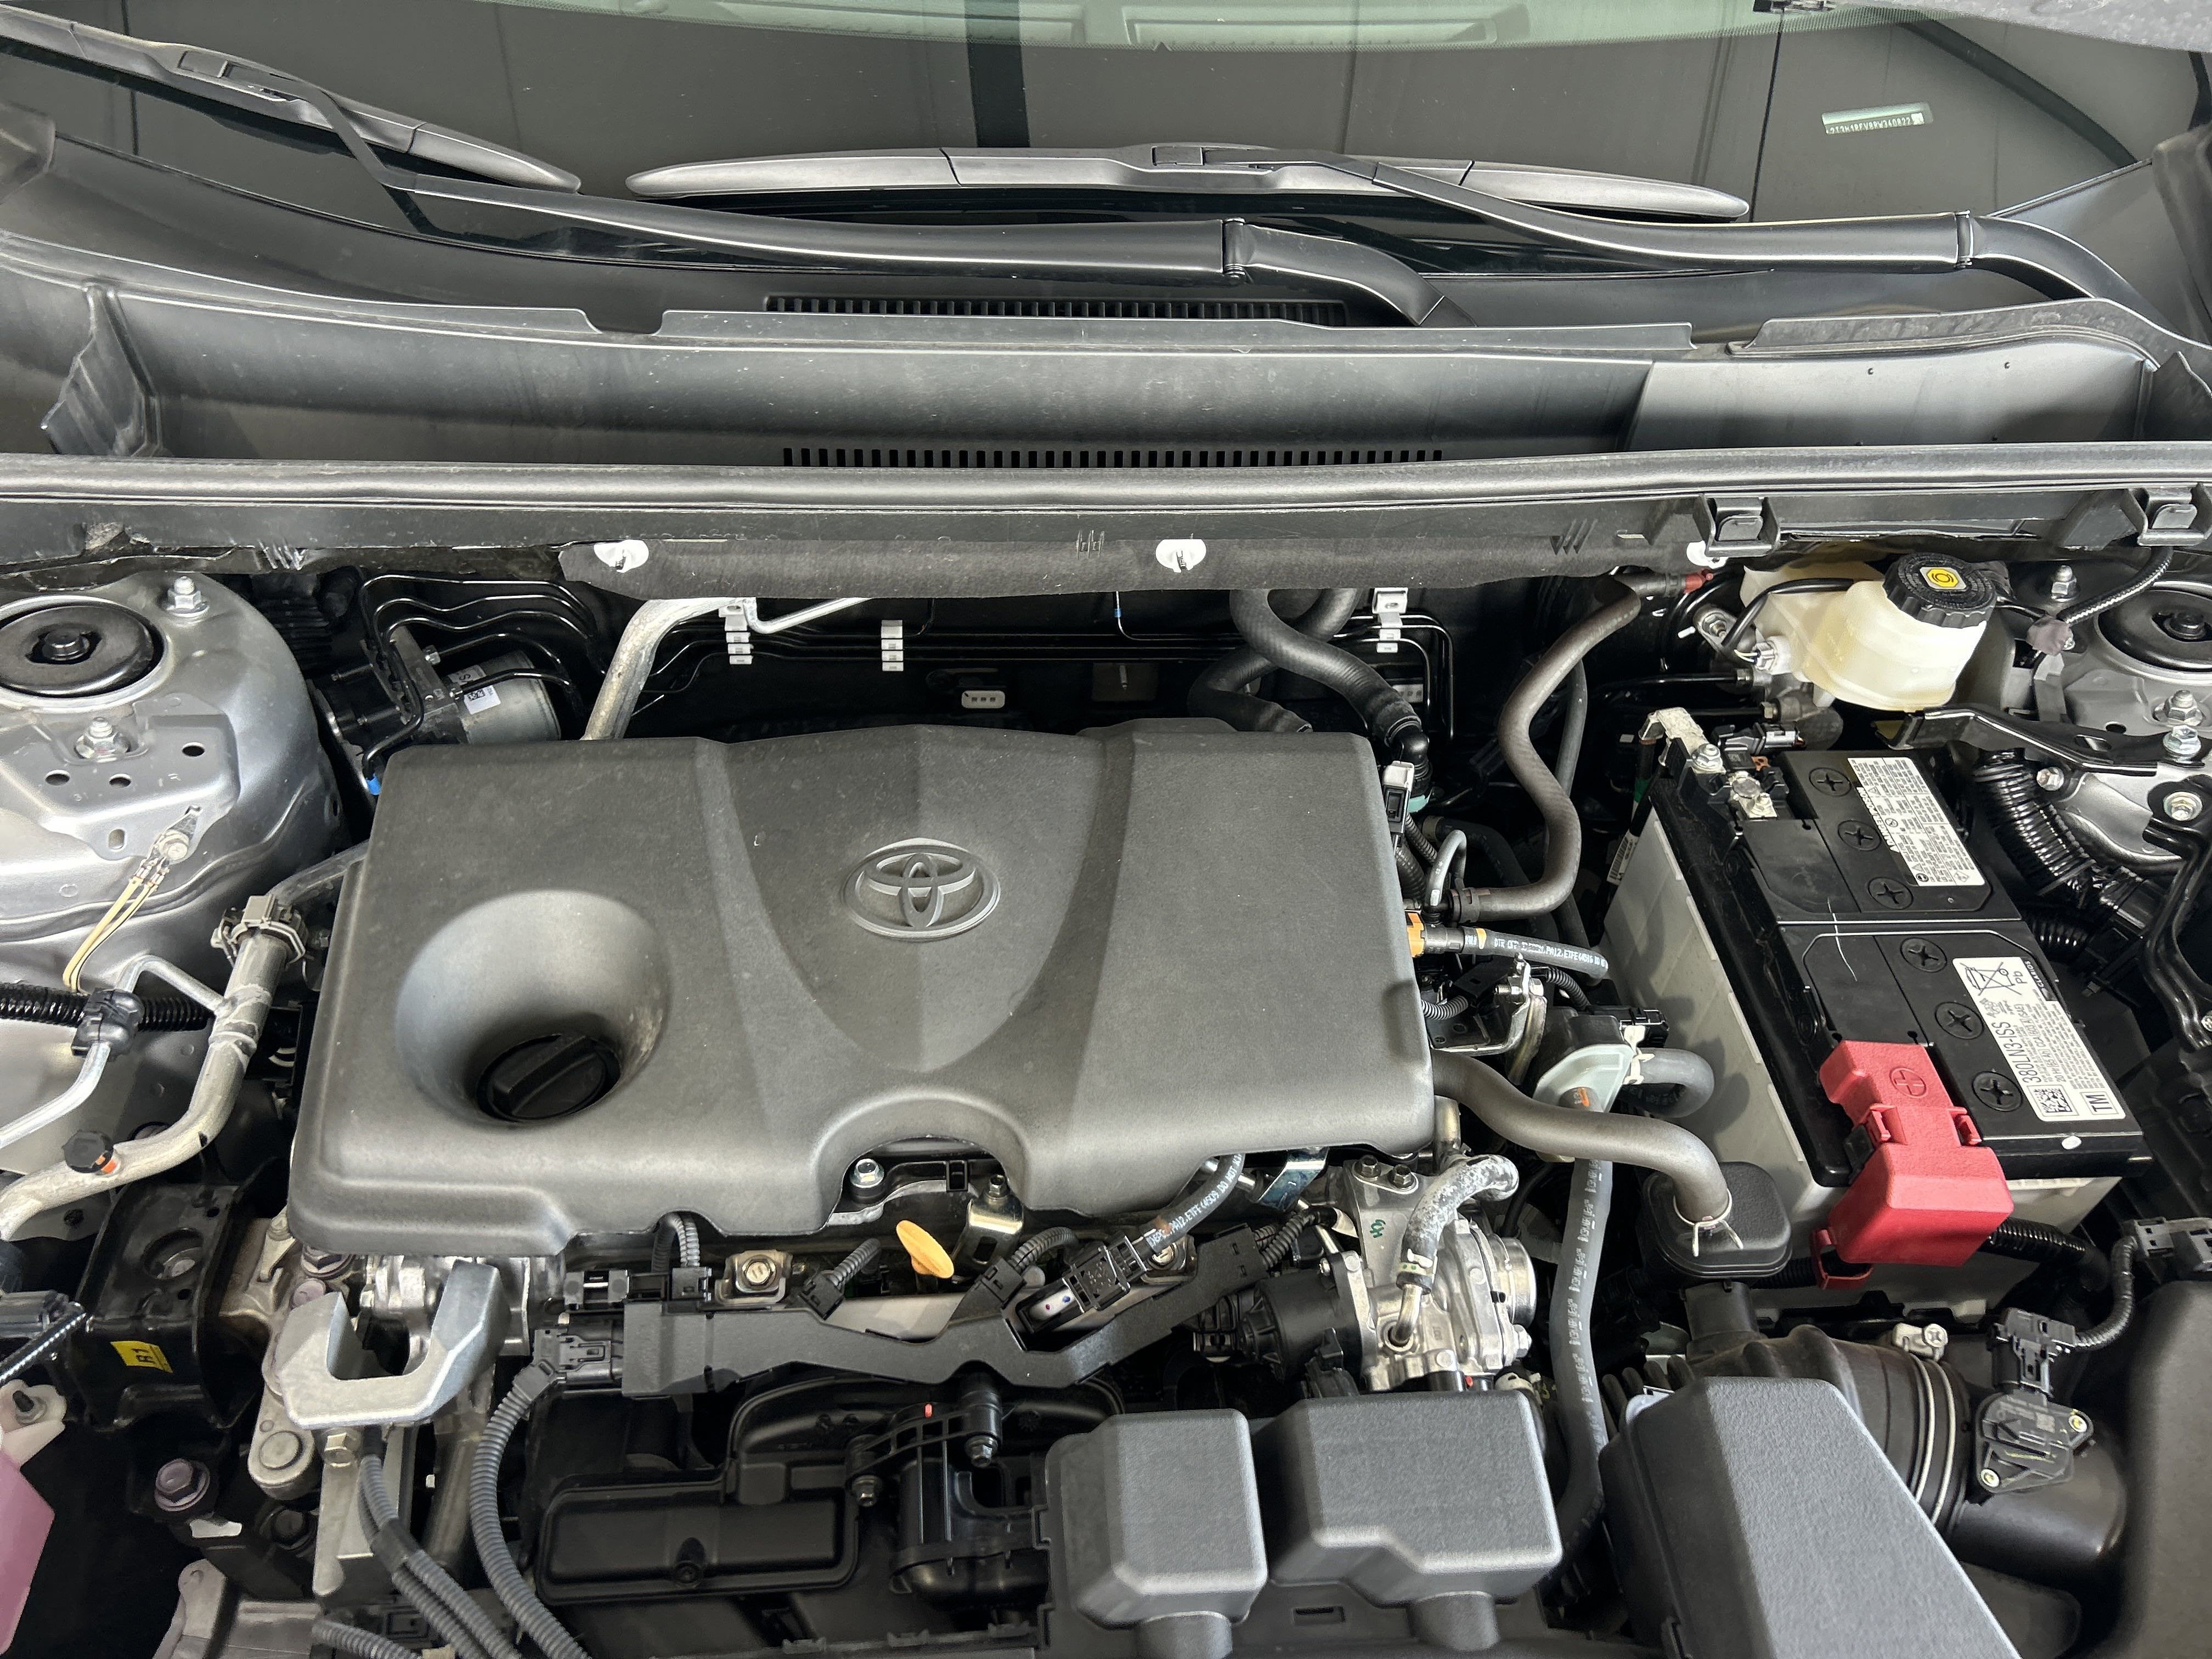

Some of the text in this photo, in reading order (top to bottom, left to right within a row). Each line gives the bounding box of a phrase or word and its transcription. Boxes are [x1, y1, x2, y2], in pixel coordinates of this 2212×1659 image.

[2013, 970, 2028, 984] Pb
[2024, 961, 2045, 987] CLARIOS
[2033, 1036, 2046, 1047] CCA
[1990, 1022, 2042, 1082] 380LN3-ISS
[2084, 1094, 2113, 1111] TM
